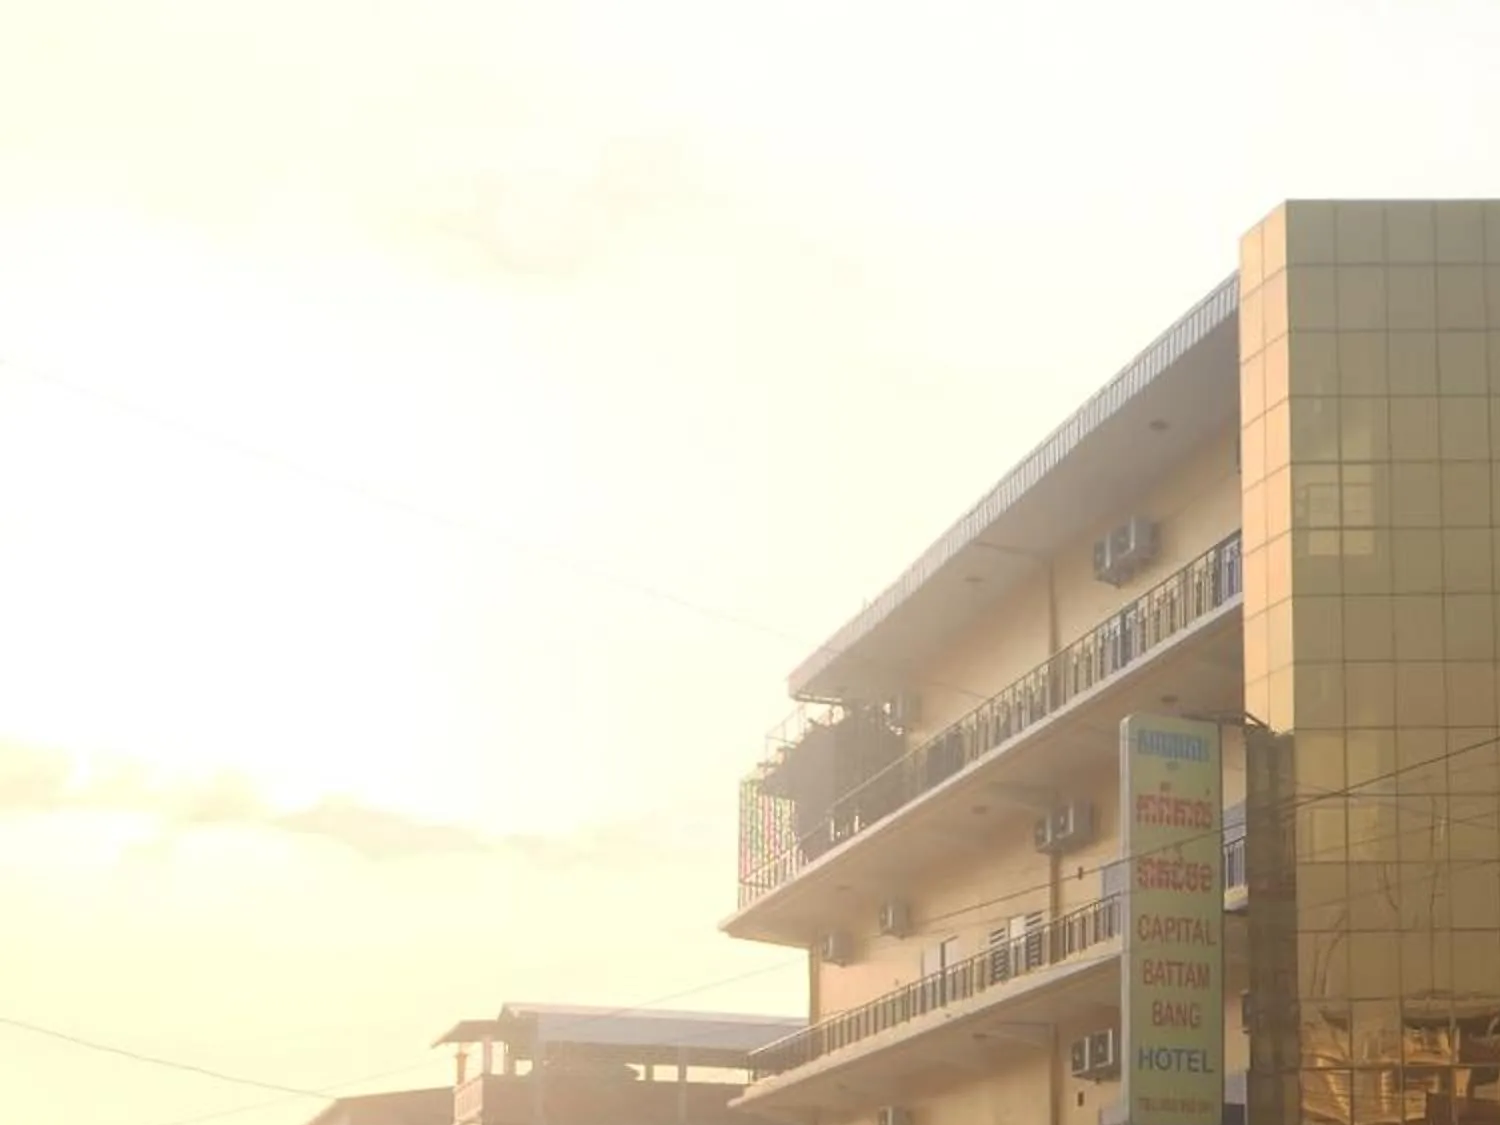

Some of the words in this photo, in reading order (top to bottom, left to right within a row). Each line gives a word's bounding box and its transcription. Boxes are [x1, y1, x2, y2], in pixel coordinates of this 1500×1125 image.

[1137, 913, 1217, 947] CAPITAL
[1143, 961, 1210, 990] BATTAM
[1152, 1000, 1201, 1029] BANG
[1138, 1046, 1214, 1073] HOTEL
